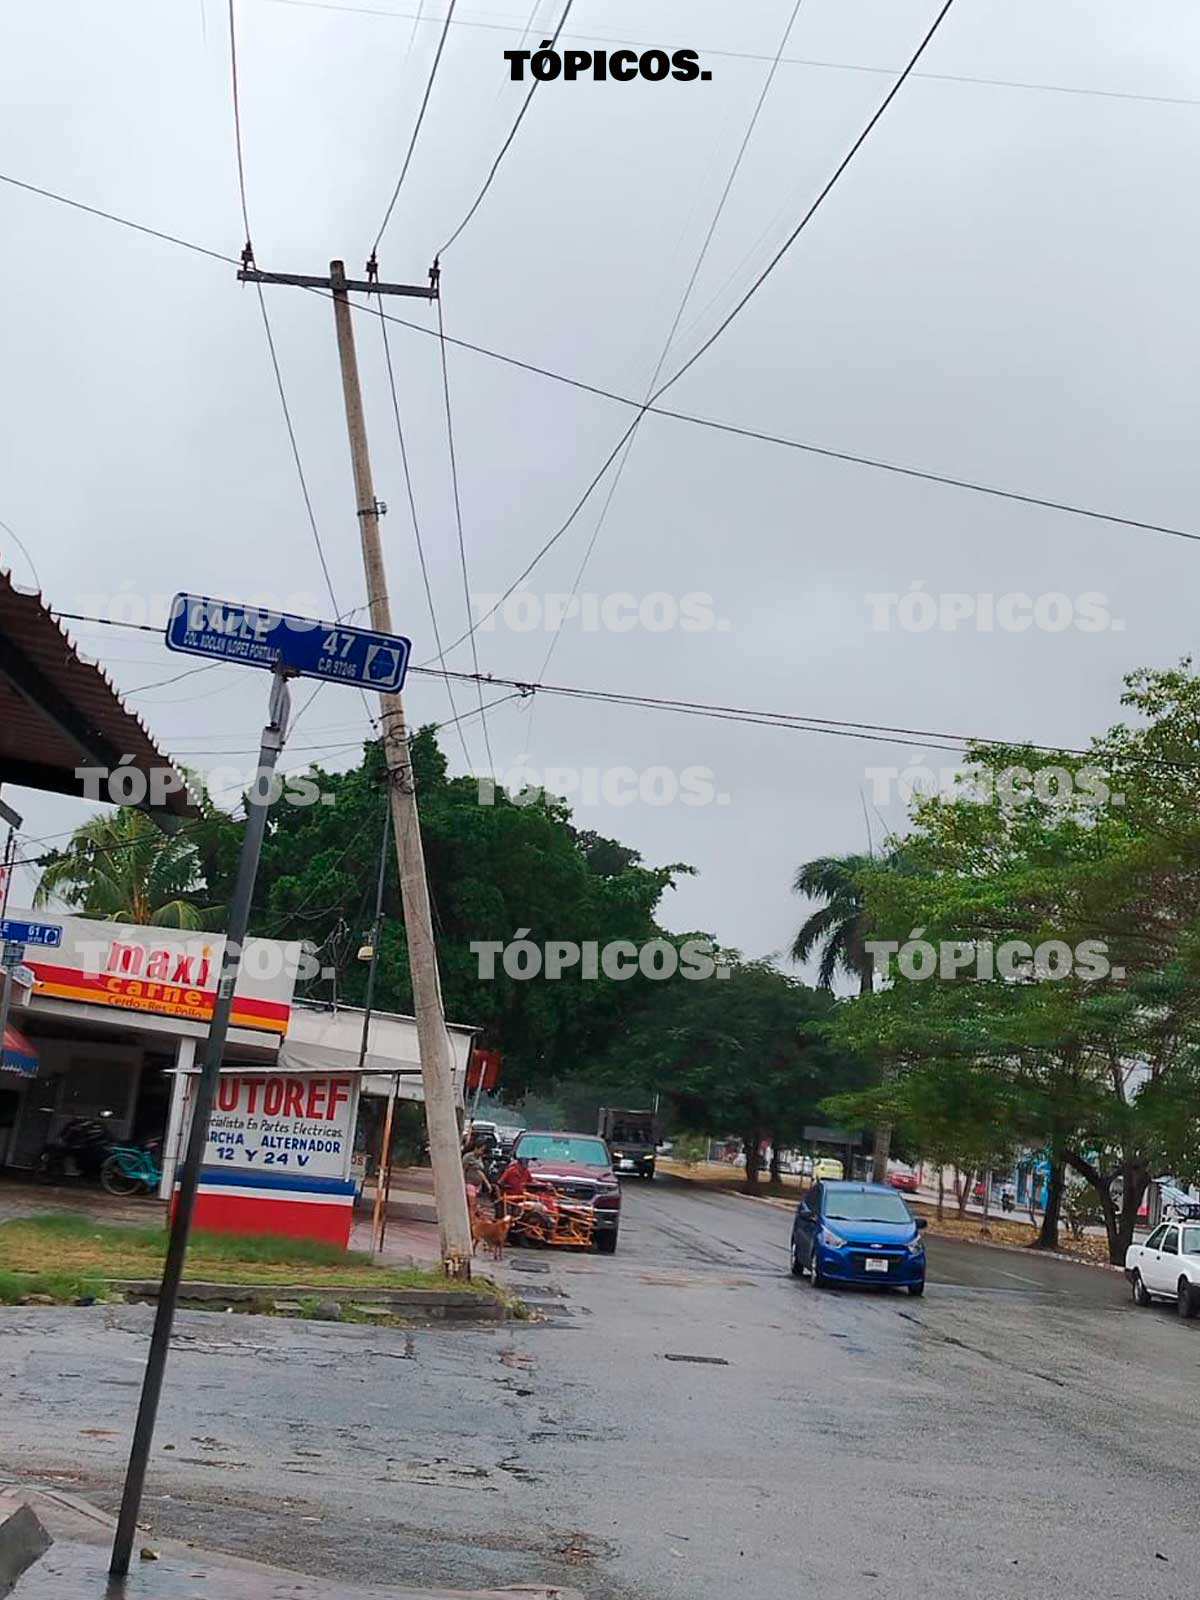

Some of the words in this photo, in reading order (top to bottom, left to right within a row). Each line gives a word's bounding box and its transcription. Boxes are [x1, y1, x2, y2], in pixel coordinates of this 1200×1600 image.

[190, 604, 270, 642] CALLE
[322, 631, 356, 657] 47
[107, 941, 211, 987] maxi
[106, 979, 202, 1006] carne
[246, 1118, 258, 1130] En
[260, 1119, 289, 1133] Partes
[208, 1131, 244, 1145] RCHA
[261, 1134, 341, 1154] ALTERNADOR
[216, 1147, 234, 1160] 12
[245, 1150, 257, 1162] Y
[264, 1151, 288, 1165] 24
[297, 1155, 310, 1167] V
